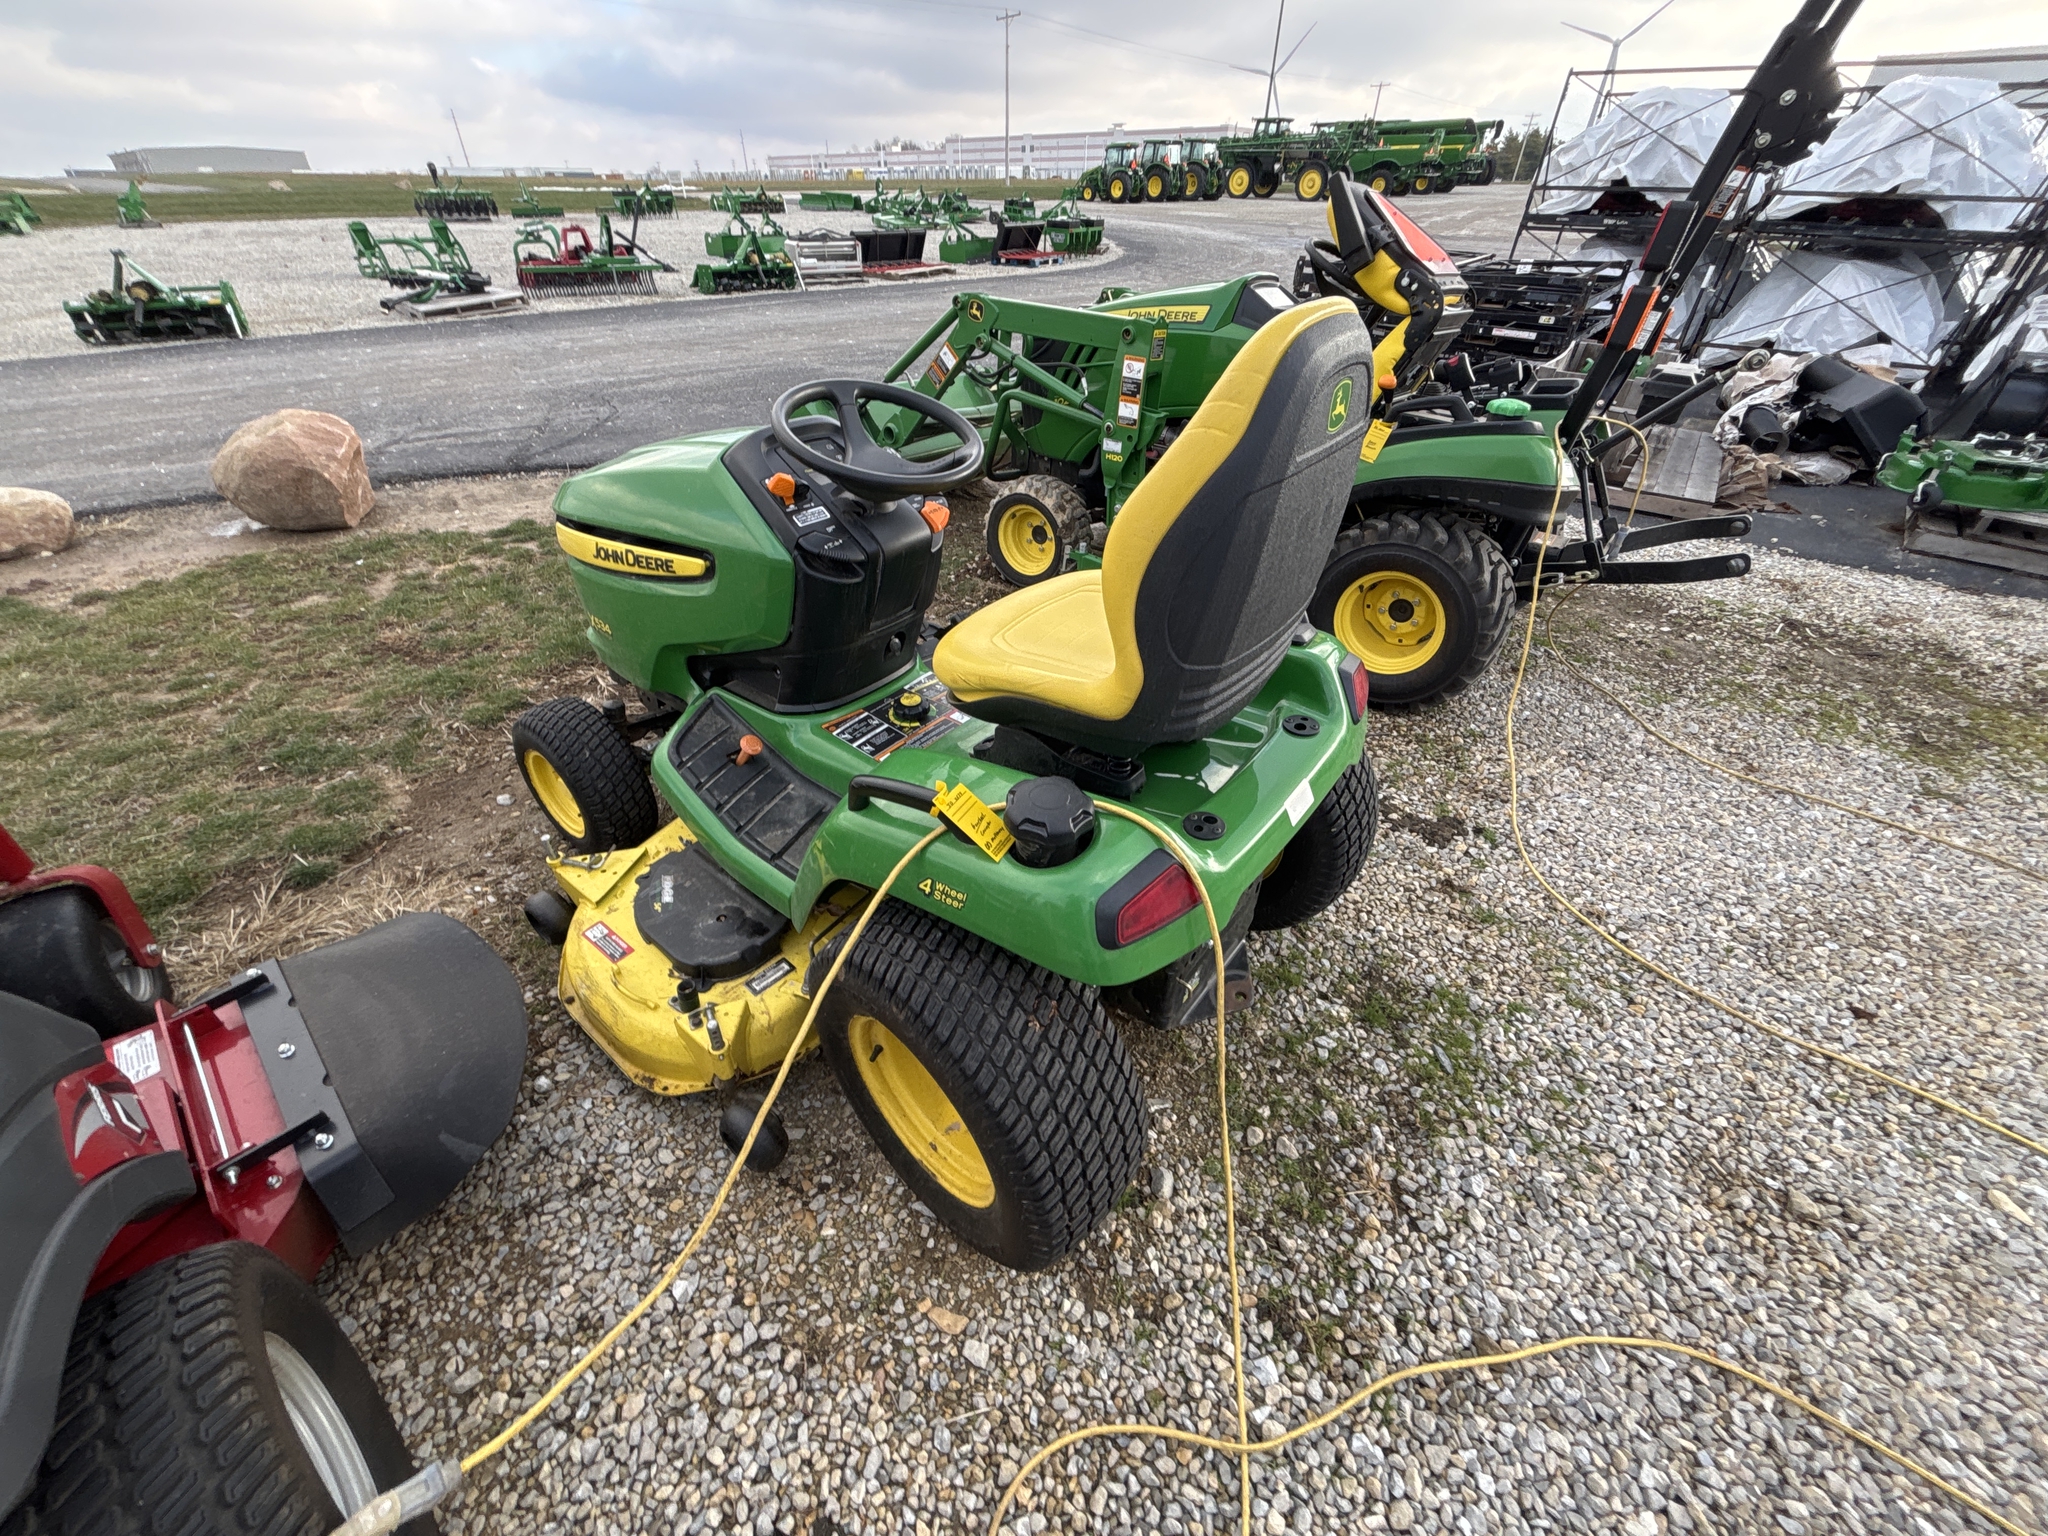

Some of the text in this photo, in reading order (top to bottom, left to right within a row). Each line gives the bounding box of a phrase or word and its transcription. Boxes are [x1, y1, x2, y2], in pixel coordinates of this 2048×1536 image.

[1127, 309, 1198, 321] JOHN DEERE
[1105, 453, 1123, 462] H120
[593, 541, 677, 575] JOHN DEERE
[918, 878, 967, 902] 4 Wheel
[933, 890, 964, 910] Steer
